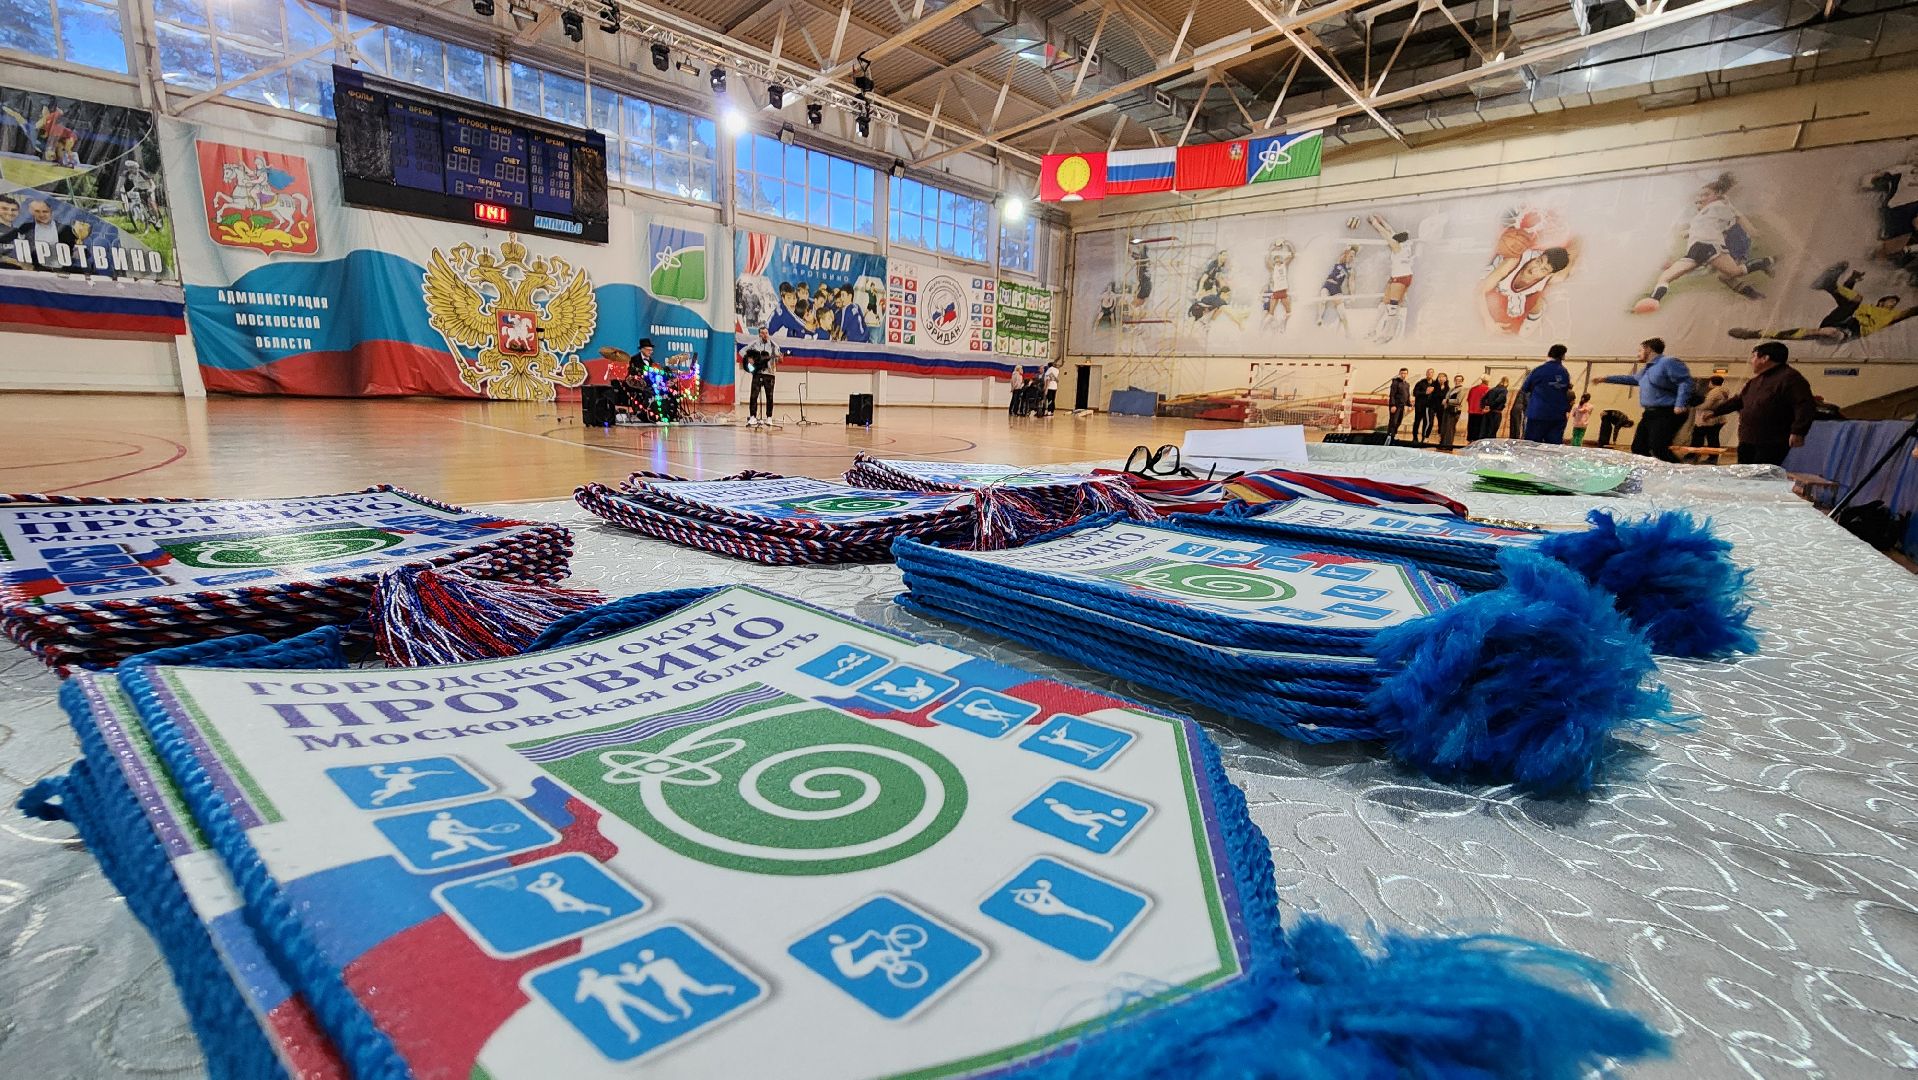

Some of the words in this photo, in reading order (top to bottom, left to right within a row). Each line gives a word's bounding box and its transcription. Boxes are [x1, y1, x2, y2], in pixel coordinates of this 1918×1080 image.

[14, 238, 163, 273] ПРОТВИНО
[782, 243, 853, 272] ГАНДБОЛ
[793, 268, 849, 282] ПРОТВИНО
[218, 289, 329, 310] АДМИНИСТРАЦИЯ
[235, 312, 321, 329] МОСКОВСКОЙ
[650, 324, 709, 339] АДМИНИСТРАЦИЯ
[926, 321, 961, 344] ЭРИДАН
[256, 336, 312, 350] ОБЛАСТИ
[667, 341, 694, 352] ГОРОДА
[281, 495, 384, 508] ОКРУГ
[243, 651, 616, 696] ГОРОДСКОЙ
[617, 602, 741, 655] ОКРУГ
[260, 616, 785, 729] ПРОТВИНО
[293, 689, 670, 752] Московская
[671, 632, 819, 692] область
